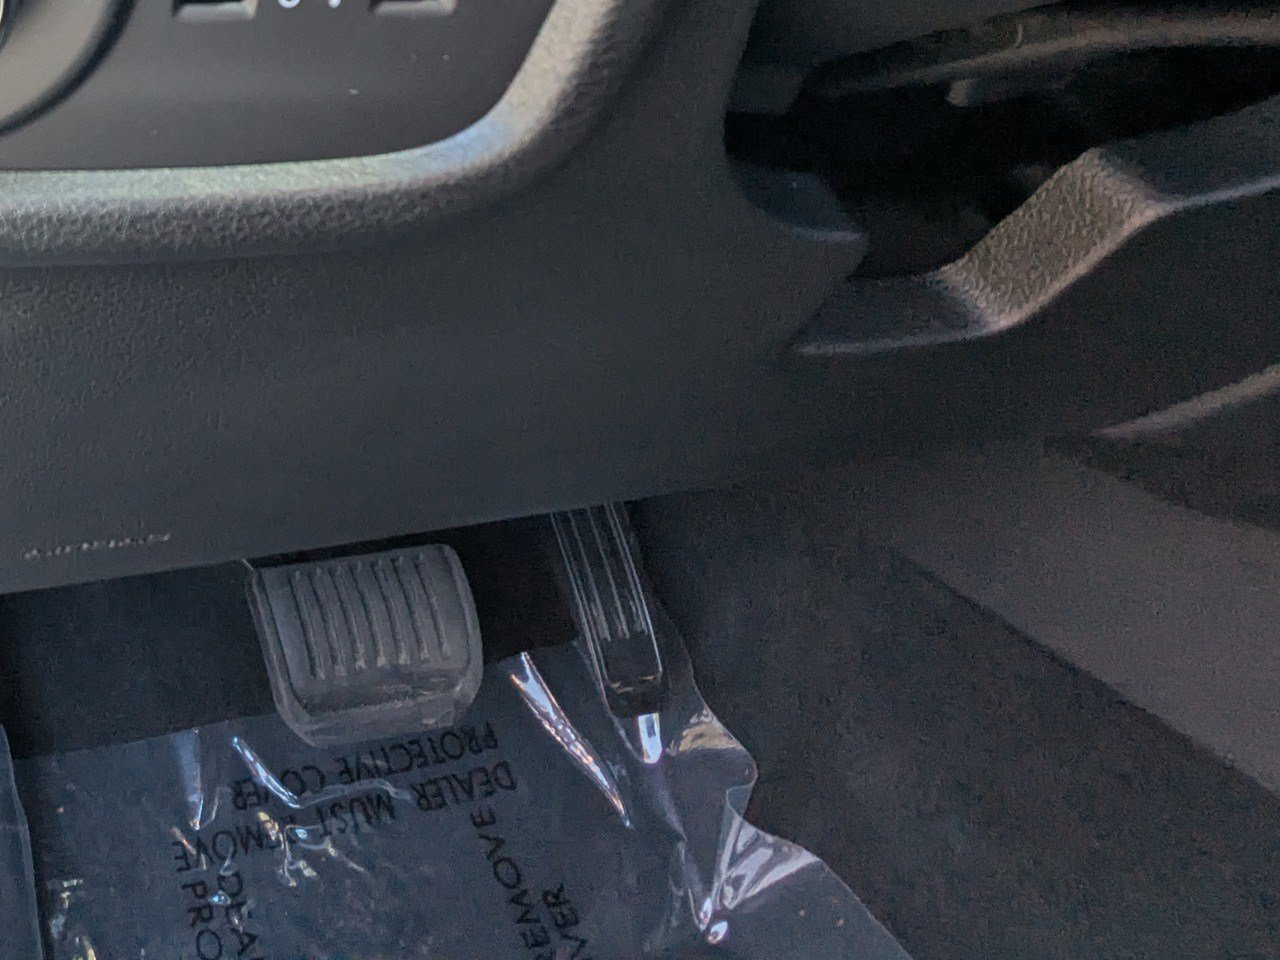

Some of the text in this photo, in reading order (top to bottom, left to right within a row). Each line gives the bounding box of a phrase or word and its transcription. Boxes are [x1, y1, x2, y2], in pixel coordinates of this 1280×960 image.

[335, 721, 500, 778] PROTECTIVE
[412, 760, 518, 811] DEALER
[319, 792, 396, 837] MUST
